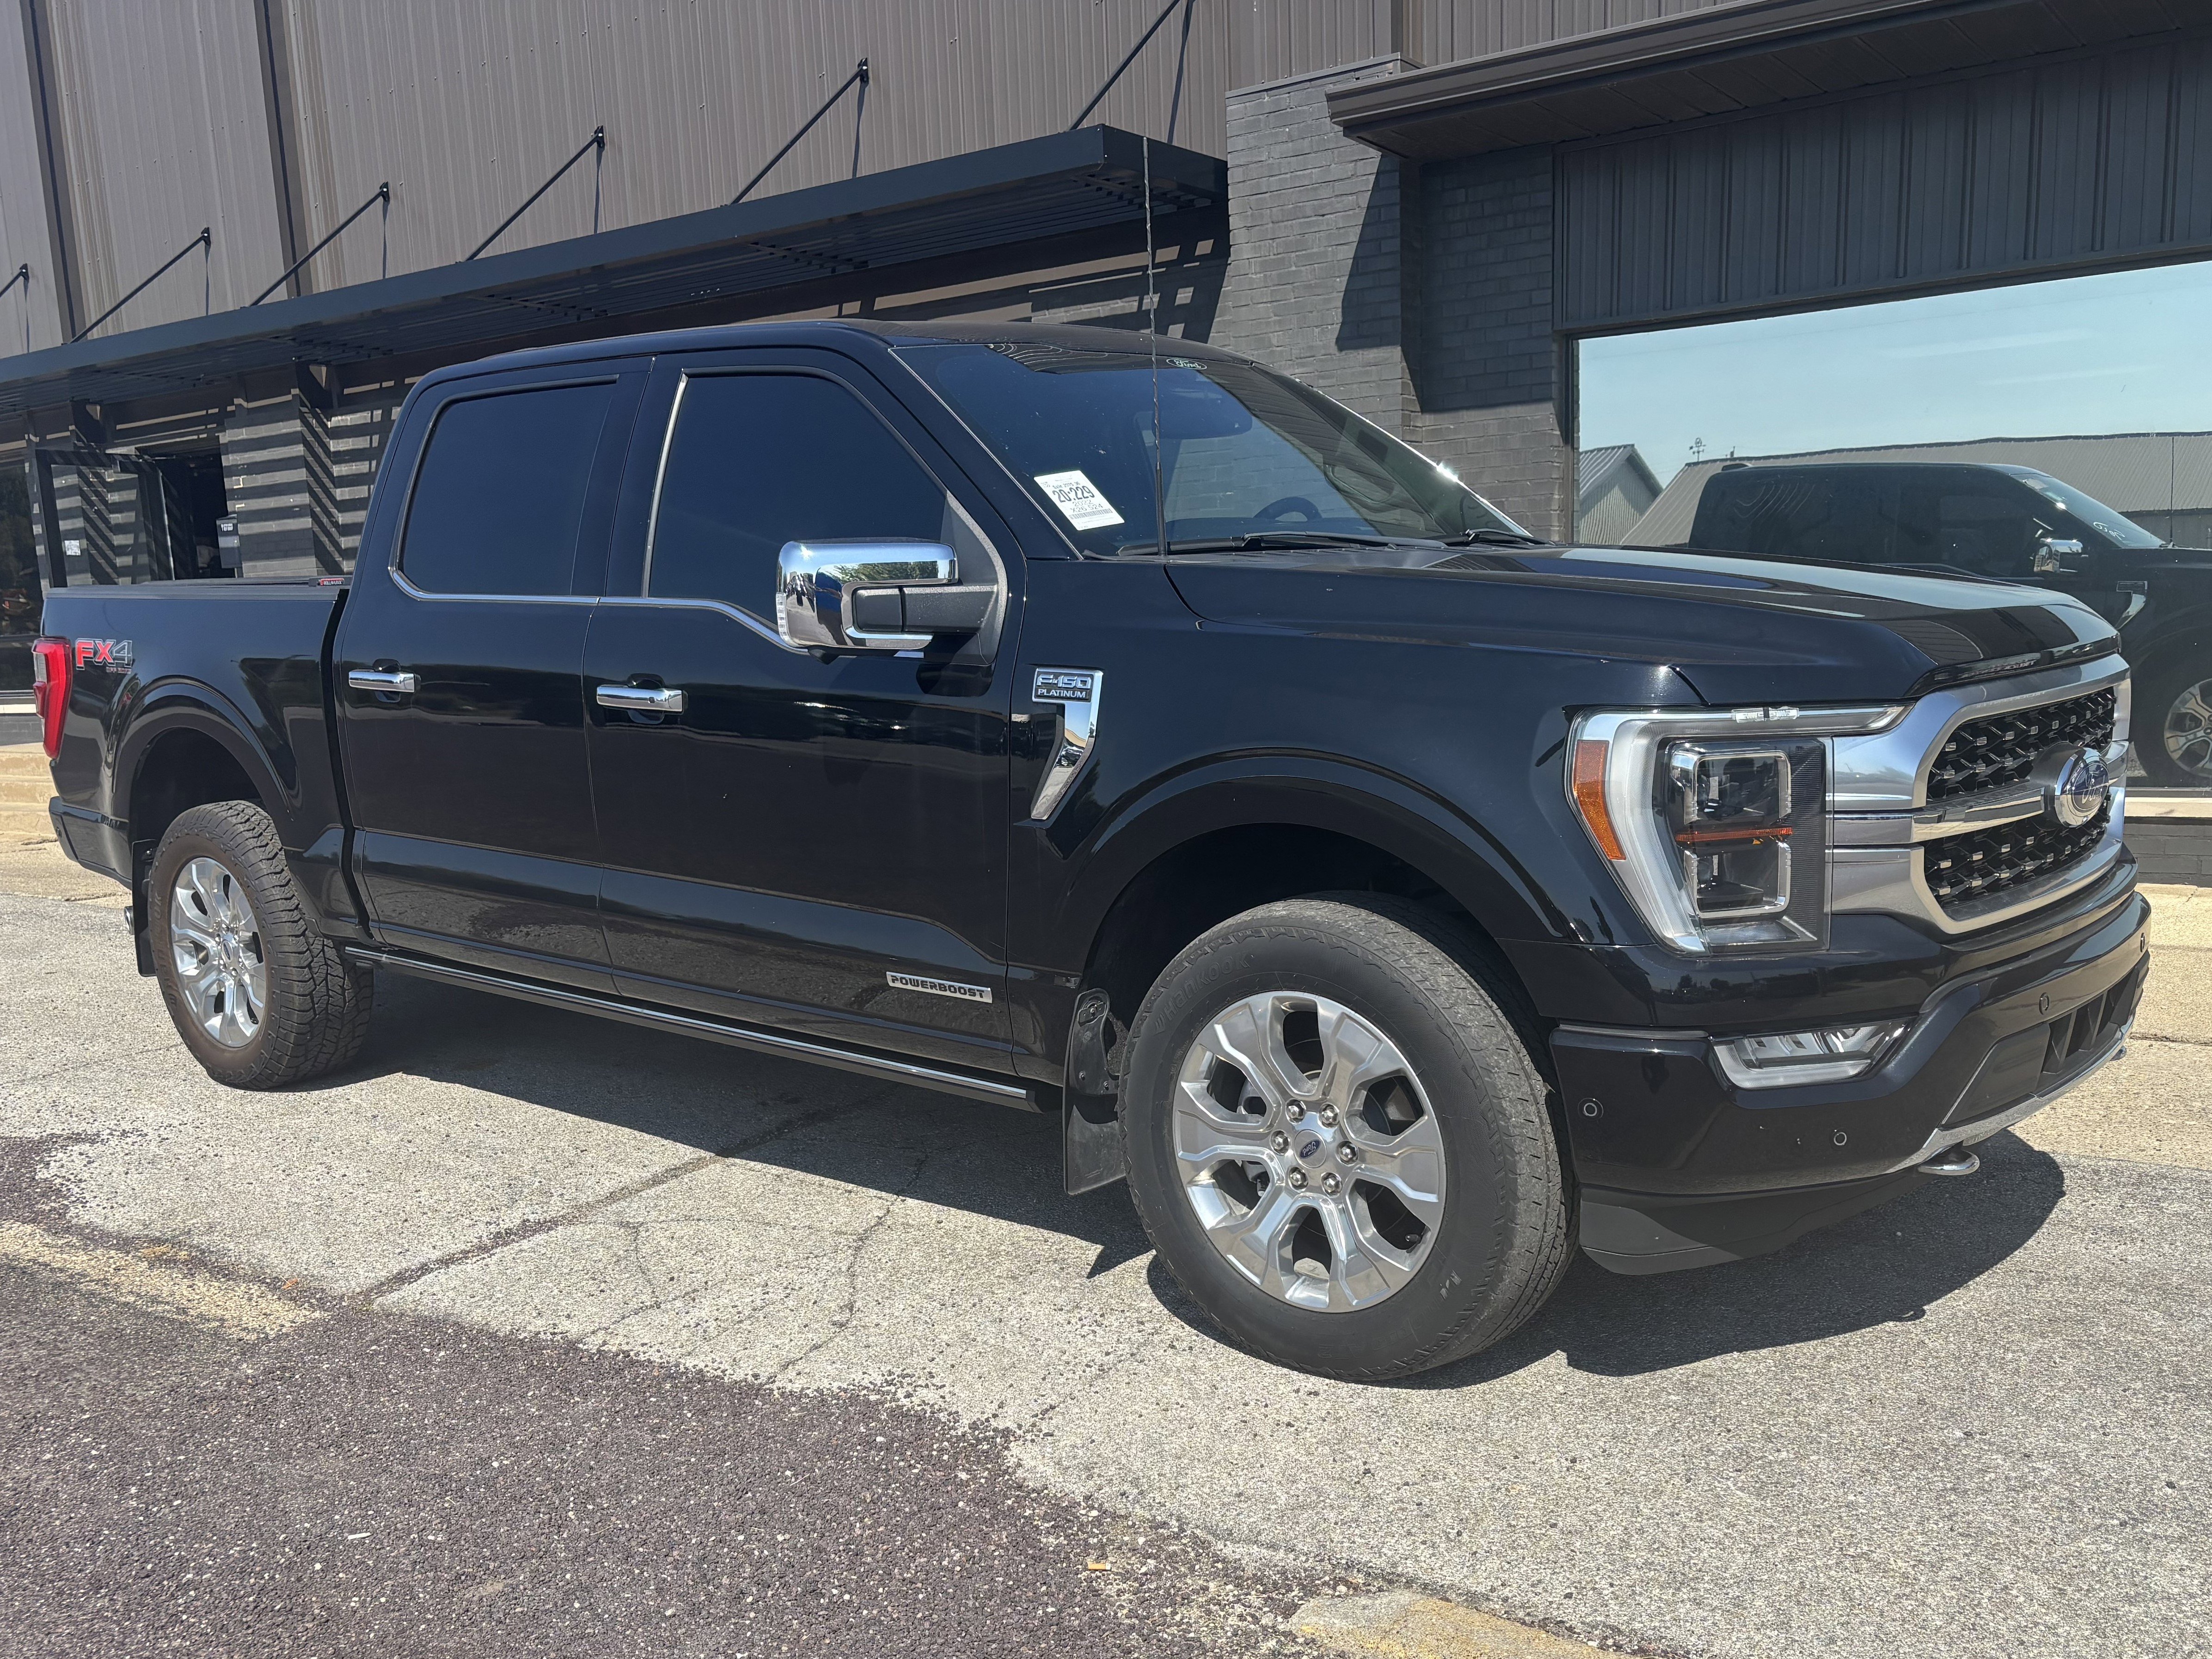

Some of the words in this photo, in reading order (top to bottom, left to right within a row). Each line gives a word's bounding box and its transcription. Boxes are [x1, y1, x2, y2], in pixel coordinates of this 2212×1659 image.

[1173, 359, 1202, 369] Ford
[1053, 485, 1095, 503] 20:229
[75, 638, 132, 670] FX4
[1037, 674, 1091, 689] F-150
[1038, 689, 1086, 698] PLATINUM
[890, 975, 985, 998] POWERBOOST
